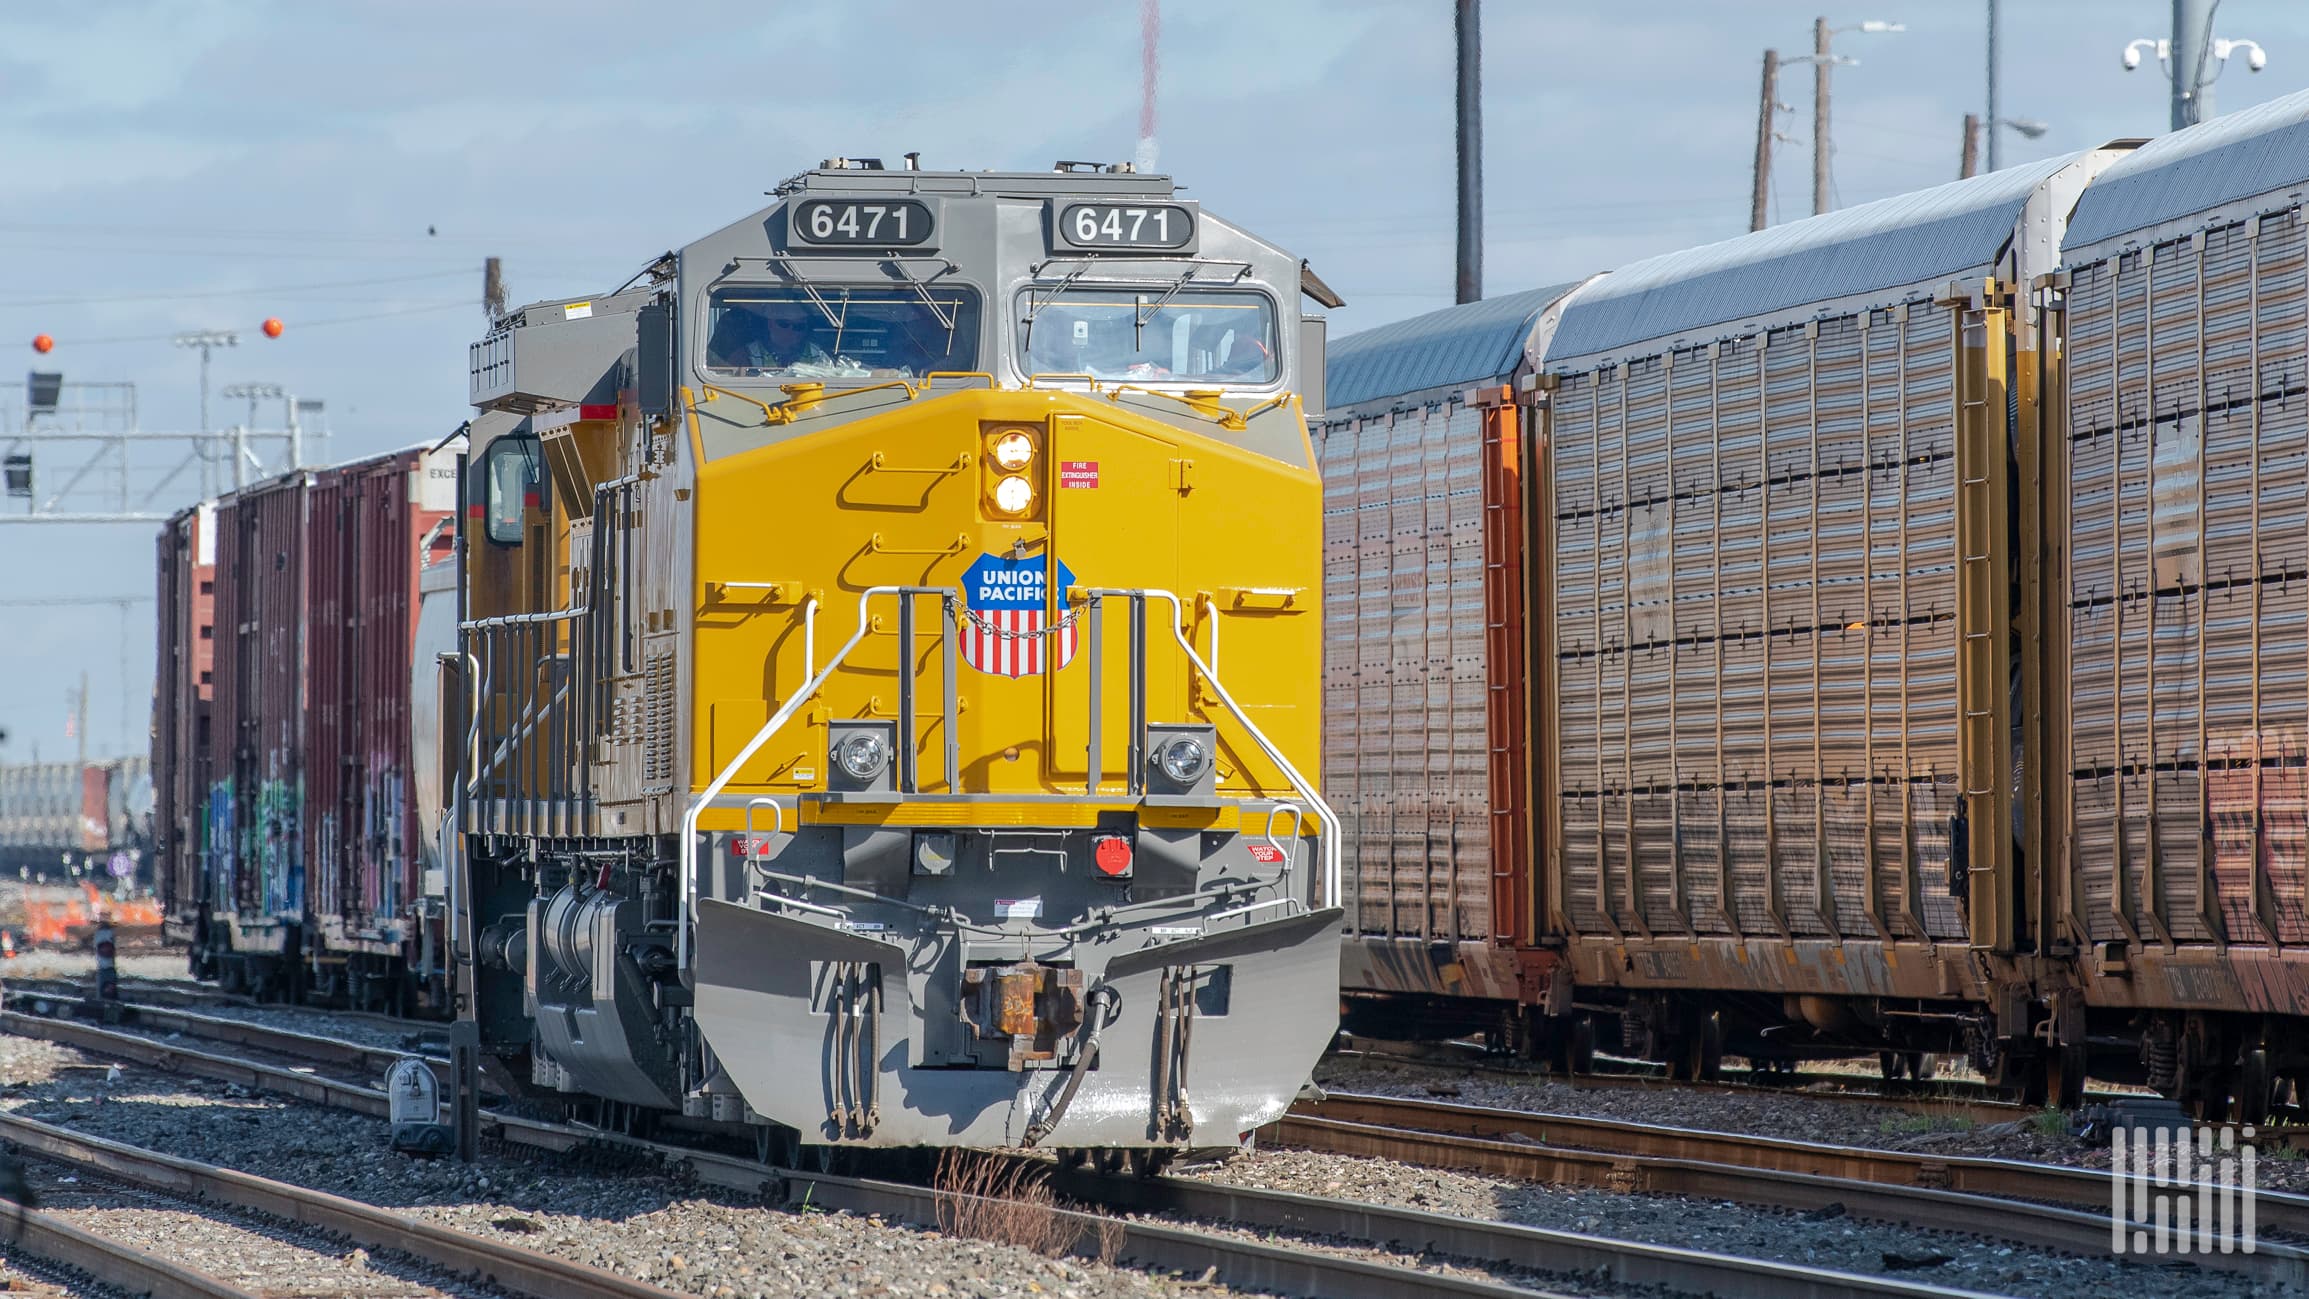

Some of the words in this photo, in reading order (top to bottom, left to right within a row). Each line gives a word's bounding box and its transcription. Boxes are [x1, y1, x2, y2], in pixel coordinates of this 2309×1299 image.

[811, 204, 908, 239] 6471
[1075, 207, 1168, 242] 6471
[1072, 462, 1088, 470] FIRE
[1068, 481, 1091, 489] INSIDE
[982, 570, 1047, 586] UNION
